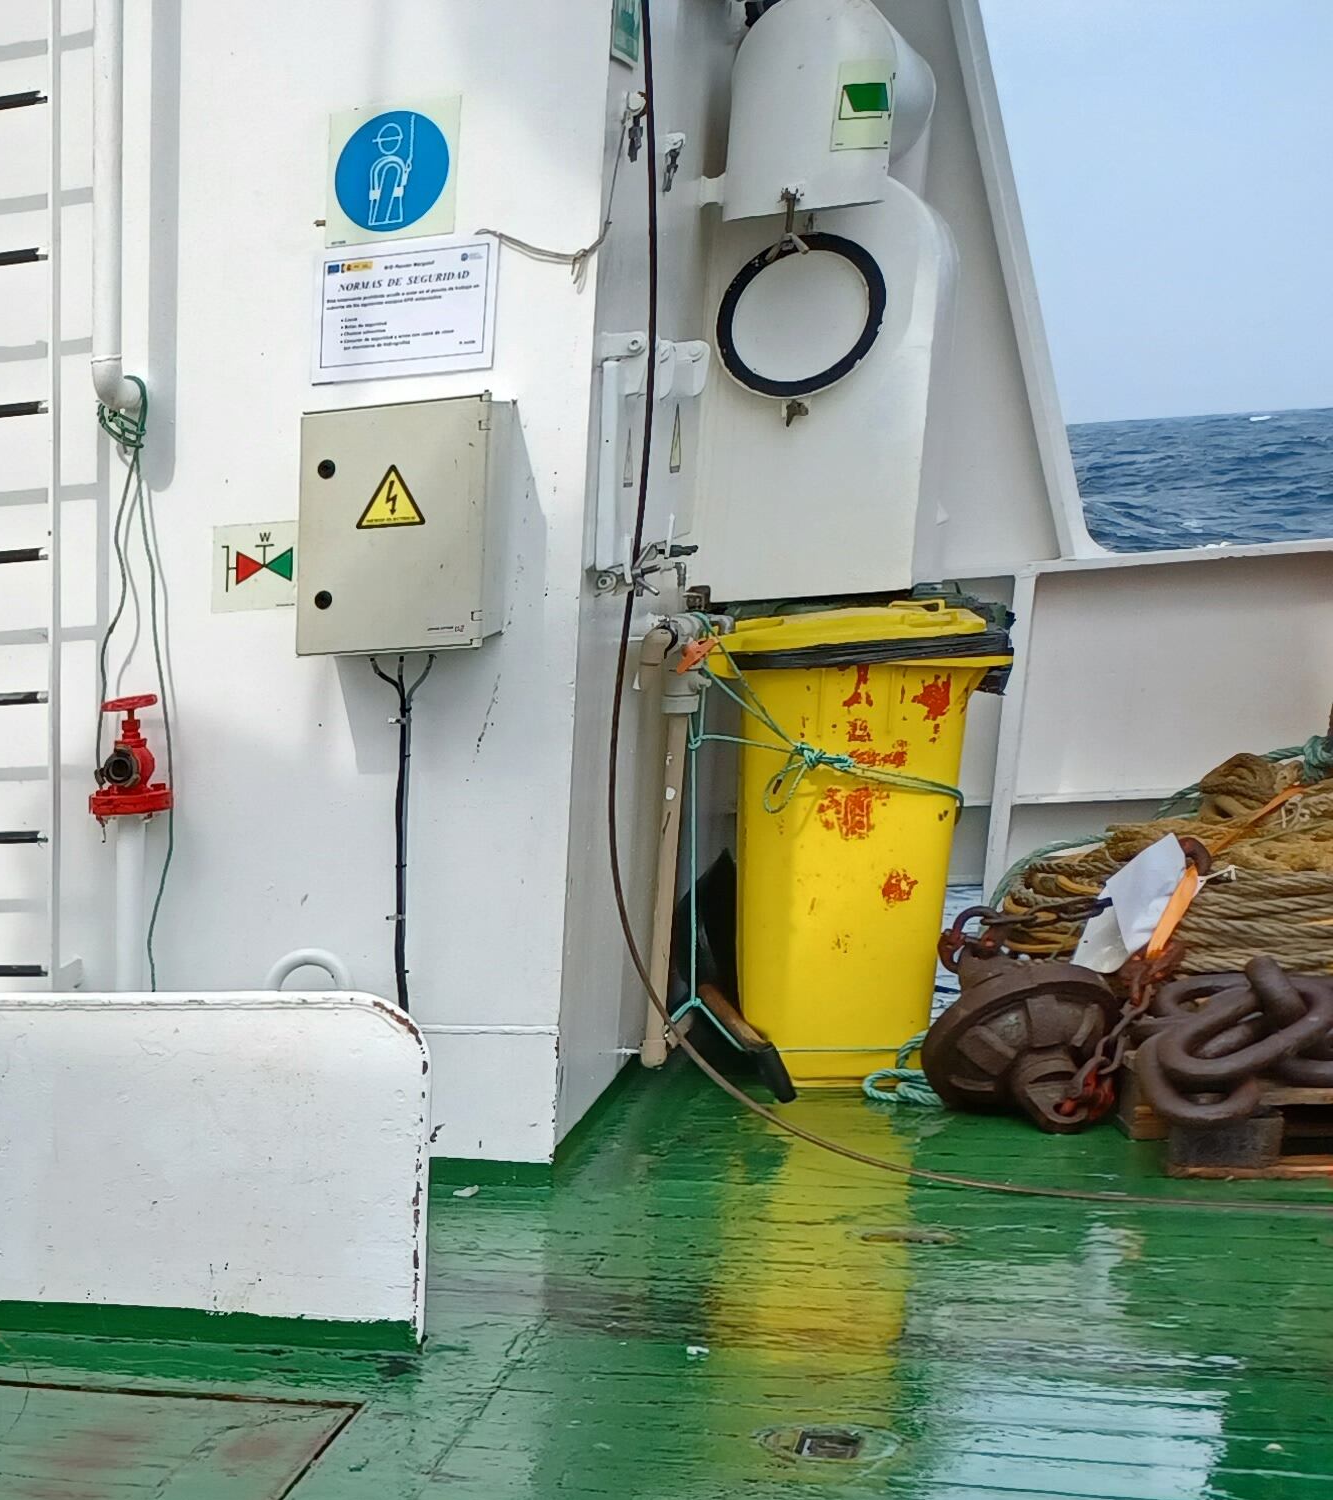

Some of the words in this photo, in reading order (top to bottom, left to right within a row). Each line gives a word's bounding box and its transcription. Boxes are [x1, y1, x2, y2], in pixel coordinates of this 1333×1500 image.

[338, 279, 383, 291] NORMAS
[387, 277, 403, 287] DE
[406, 270, 470, 285] SEGURIDAD
[259, 531, 271, 542] W
